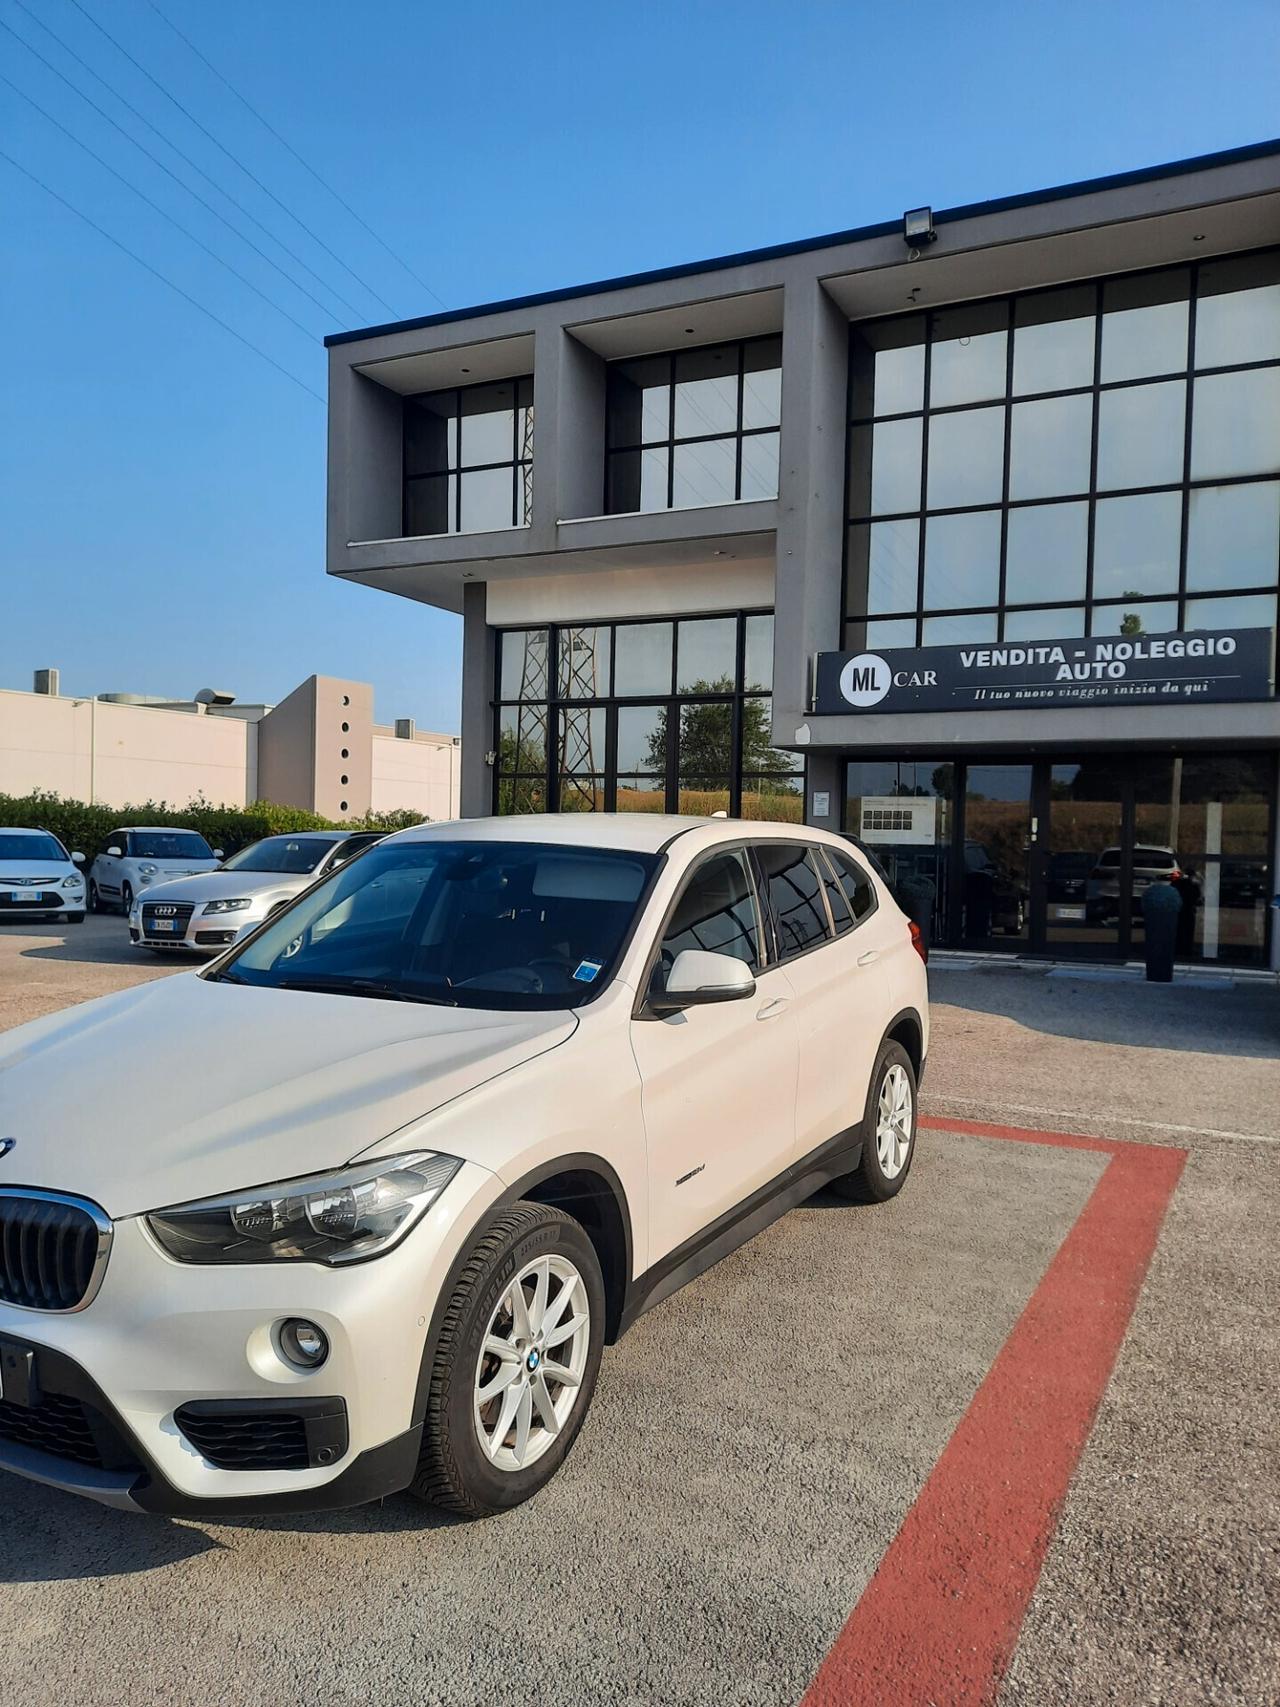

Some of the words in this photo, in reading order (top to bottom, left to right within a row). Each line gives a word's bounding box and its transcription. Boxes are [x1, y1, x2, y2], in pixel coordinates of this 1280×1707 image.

[960, 646, 1066, 668] VENDITA
[1095, 637, 1237, 661] NOLEGGIO
[852, 667, 881, 692] ML
[893, 670, 938, 687] CAR
[1055, 661, 1127, 681] AUTO
[974, 690, 987, 700] Il
[990, 690, 1010, 700] tuo
[1015, 689, 1054, 699] nuovo
[1059, 685, 1109, 699] viaggio
[1114, 683, 1157, 695] inizia
[1161, 682, 1179, 693] da
